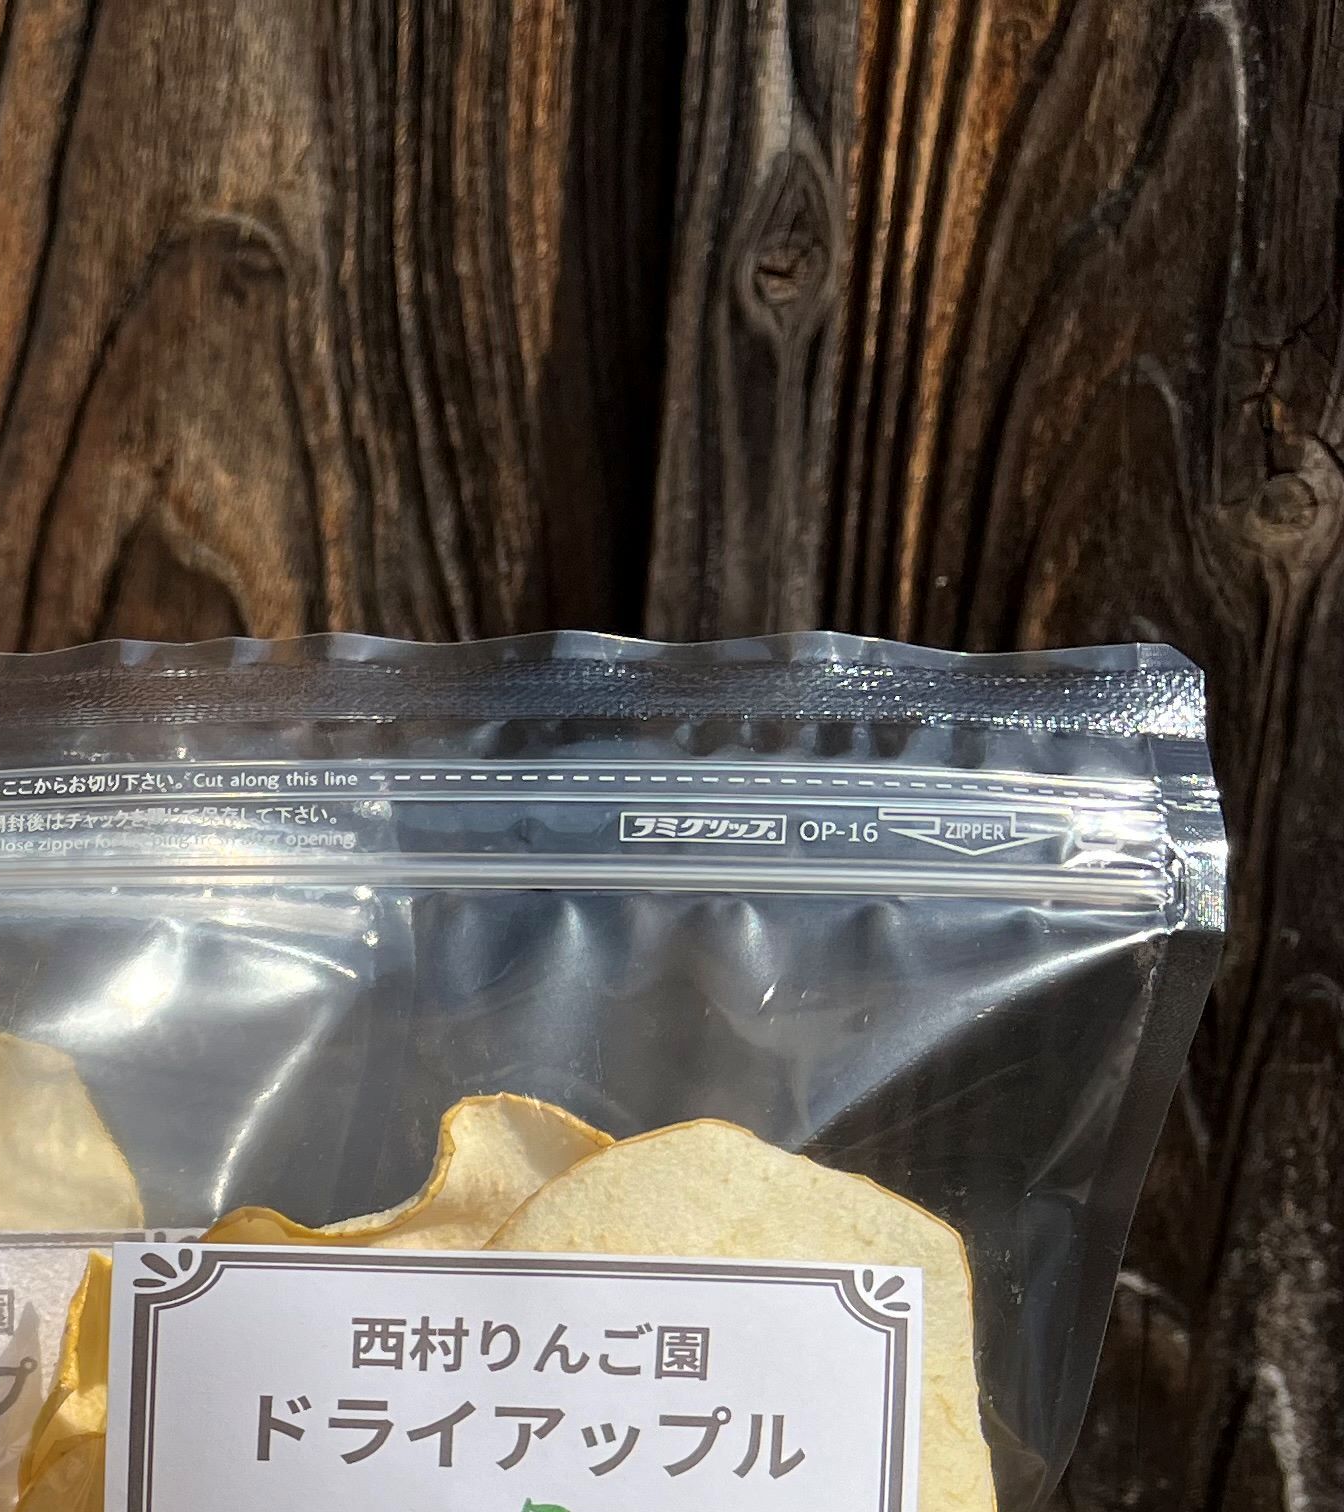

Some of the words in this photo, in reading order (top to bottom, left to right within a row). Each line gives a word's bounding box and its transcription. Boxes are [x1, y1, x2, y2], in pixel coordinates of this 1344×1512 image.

[2, 773, 183, 795] ここからお切り下さい。
[193, 773, 224, 788] Cut
[230, 772, 280, 790] along
[286, 772, 318, 786] this
[324, 771, 358, 786] line
[799, 821, 878, 843] OP-16
[945, 822, 1006, 841] ZIPPER
[38, 837, 93, 856] zipper
[285, 832, 355, 849] opening
[351, 1315, 710, 1381] 西村りんご園
[255, 1395, 806, 1480] ドライアップル
